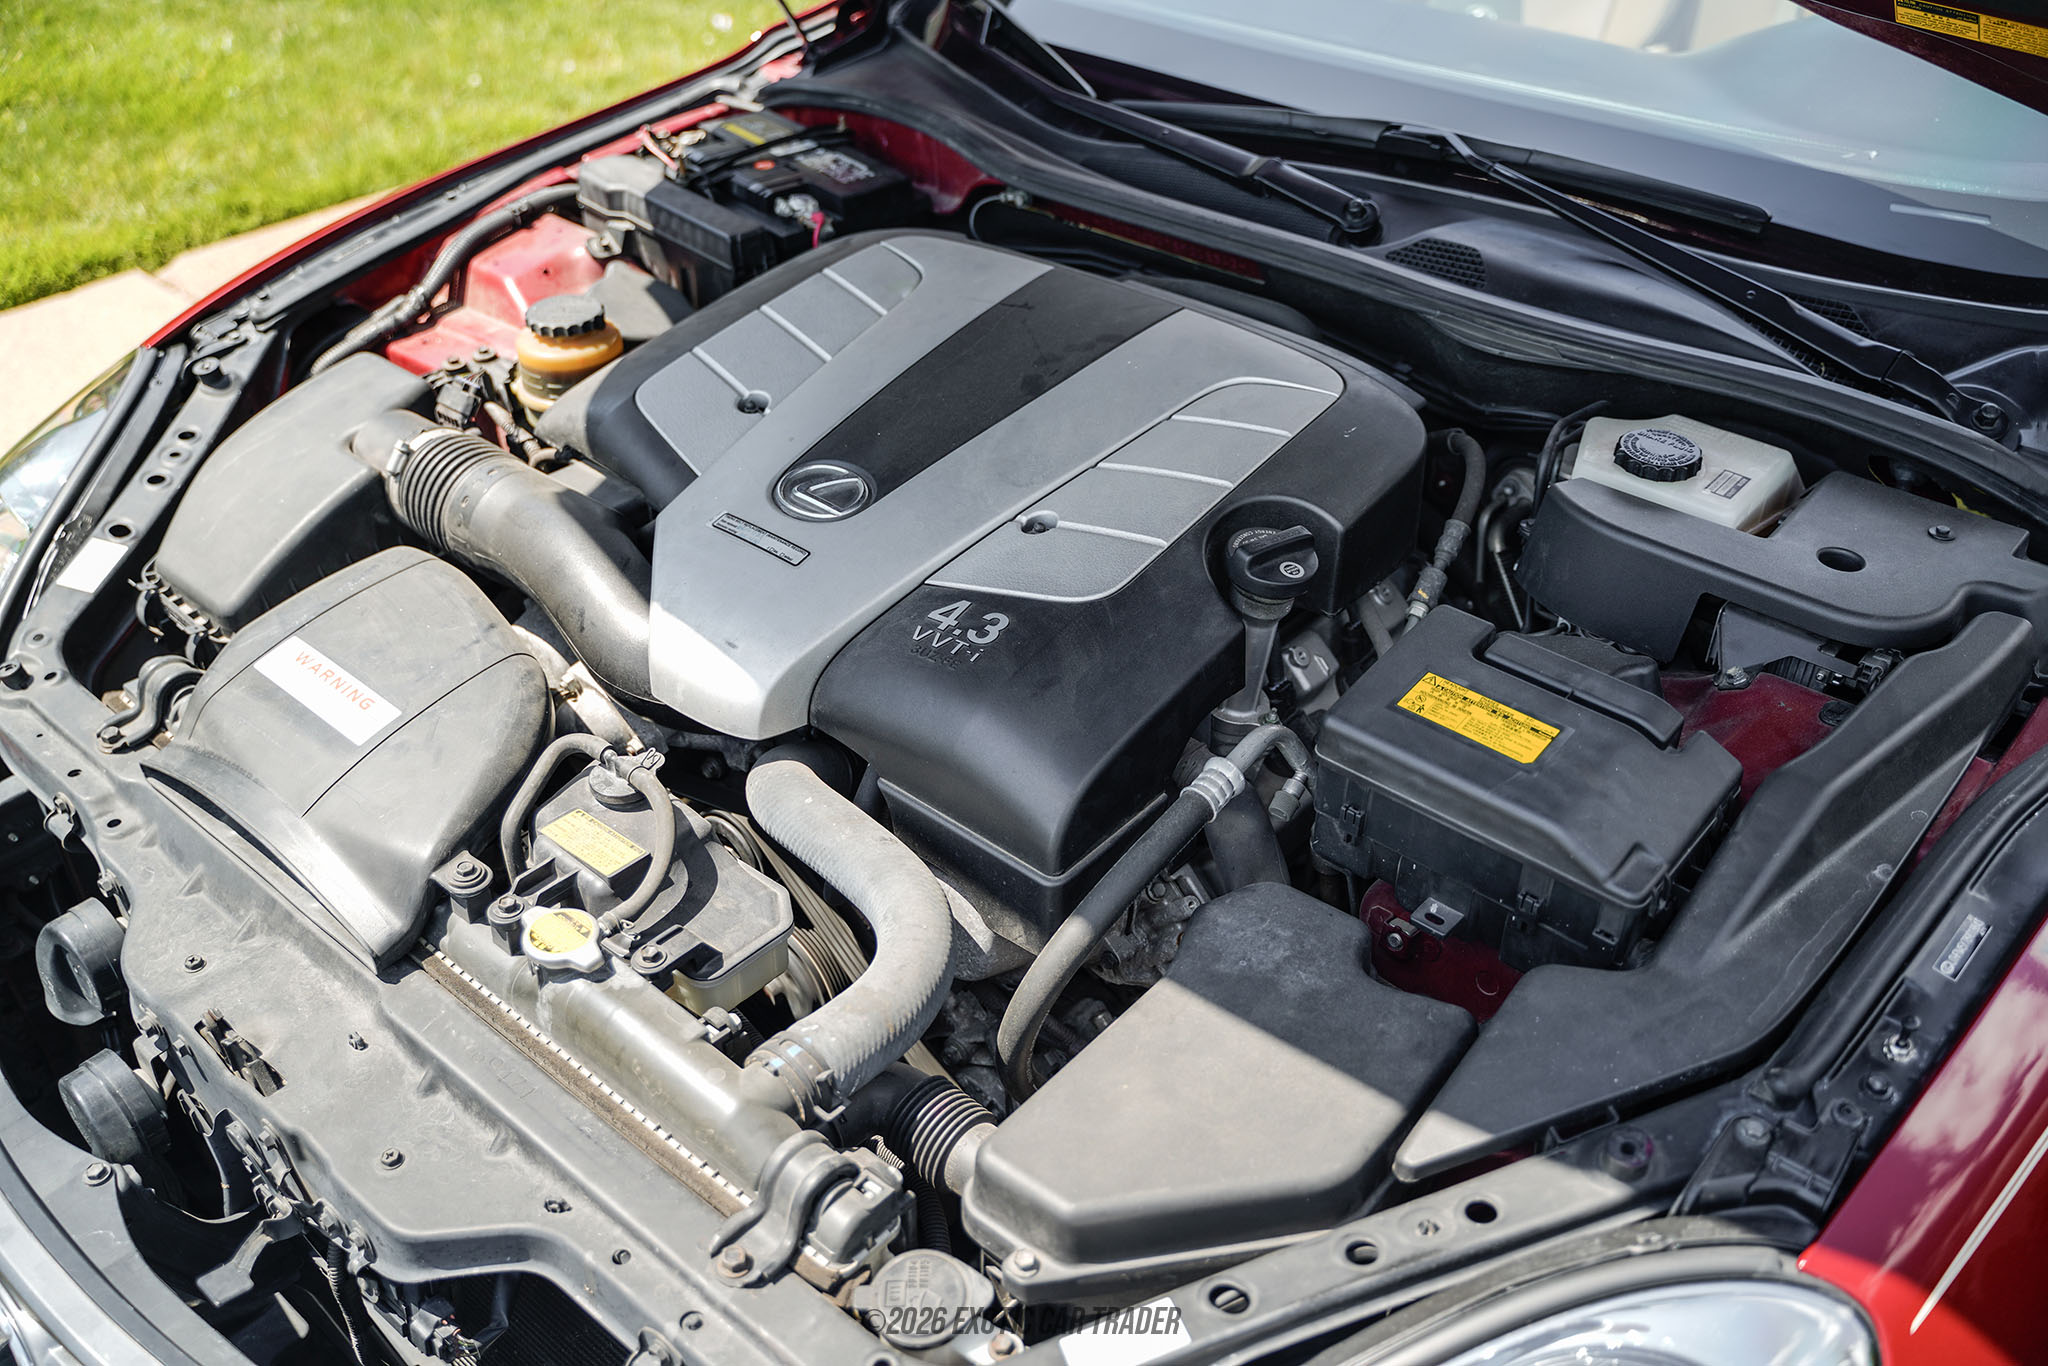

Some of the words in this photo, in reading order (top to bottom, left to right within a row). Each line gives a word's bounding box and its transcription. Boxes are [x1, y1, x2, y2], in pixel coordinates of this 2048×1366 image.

[912, 625, 984, 663] VVT-i
[927, 599, 1010, 644] 4.3
[295, 651, 376, 711] WARNING
